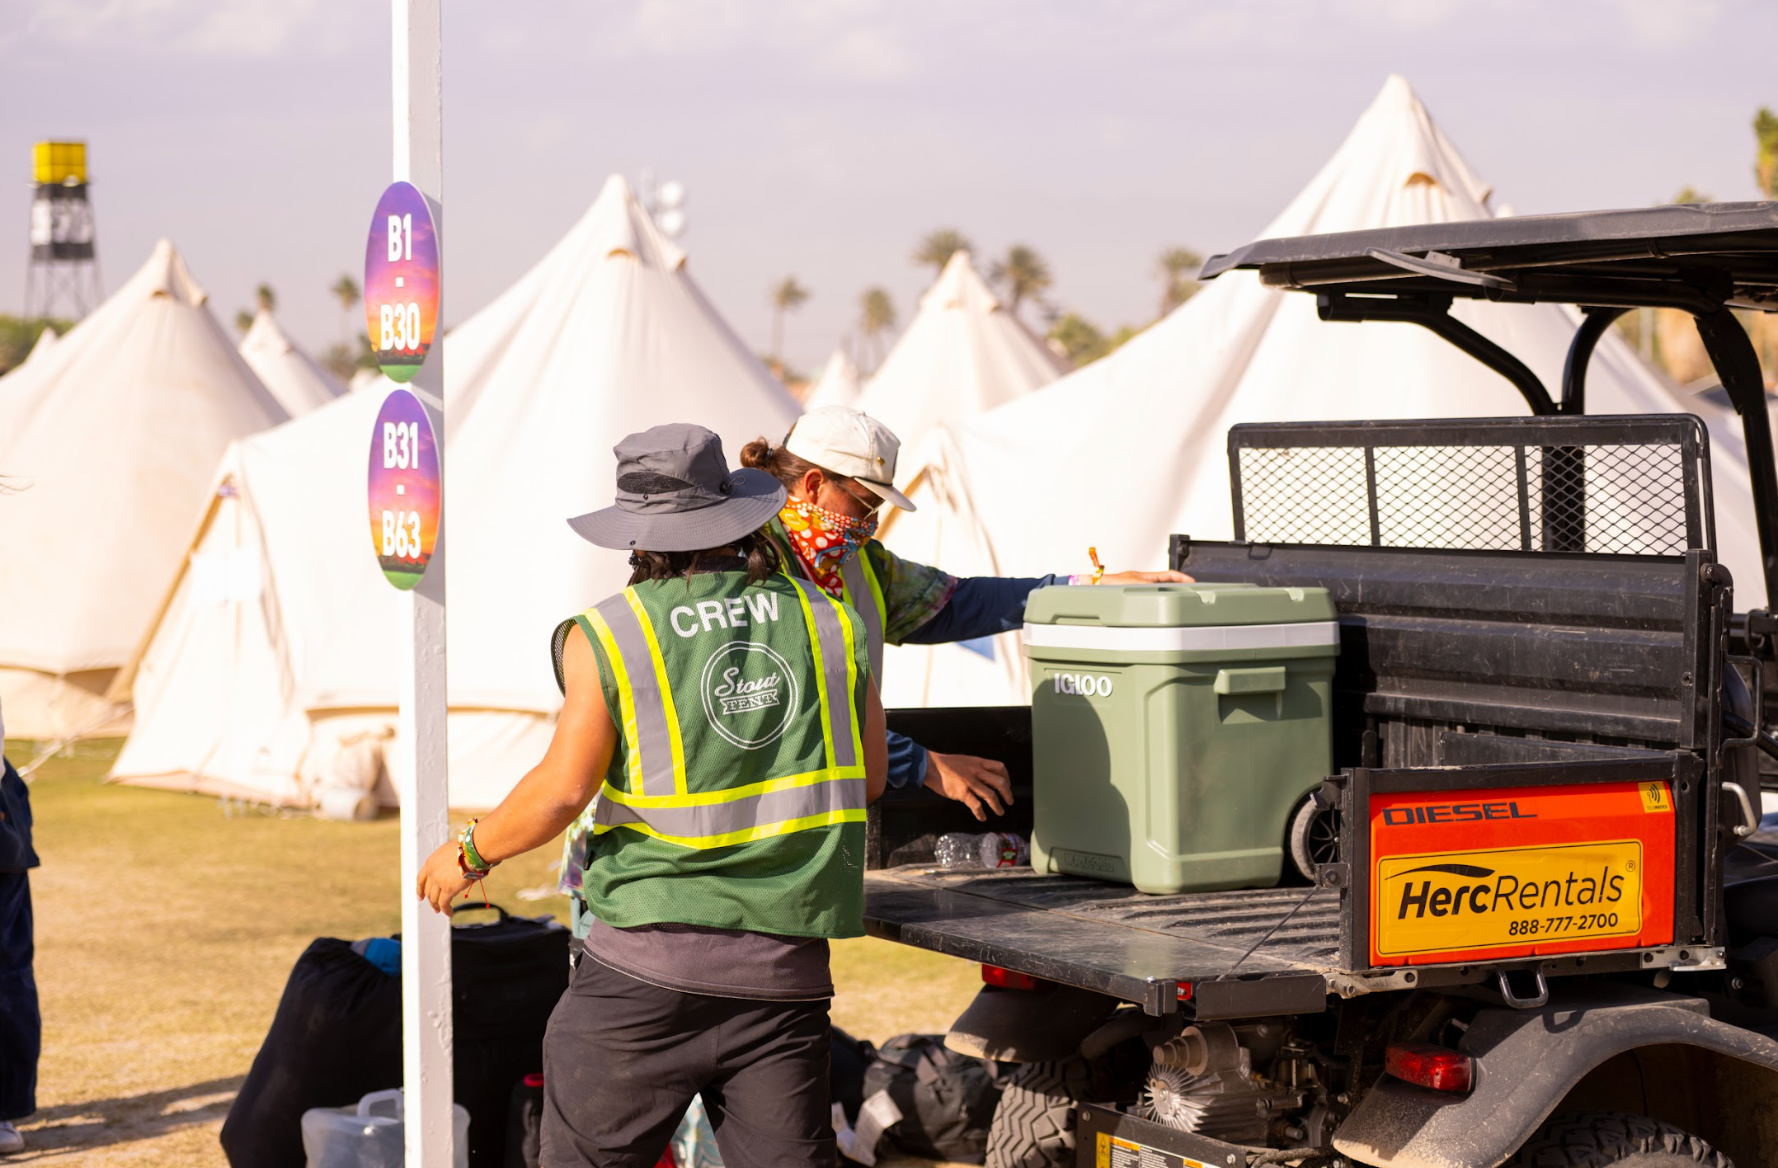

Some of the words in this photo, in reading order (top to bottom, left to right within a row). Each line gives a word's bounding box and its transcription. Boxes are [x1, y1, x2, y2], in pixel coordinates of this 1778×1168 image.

[387, 213, 412, 262] B1
[380, 302, 420, 351] B30
[383, 421, 419, 470] B31
[382, 510, 422, 560] B63
[670, 592, 779, 638] CREW
[714, 667, 780, 697] Stout
[1054, 672, 1113, 698] IGLOO
[726, 693, 773, 711] TENT
[1382, 801, 1538, 827] DIESEL
[1508, 912, 1619, 937] 888-777-2700
